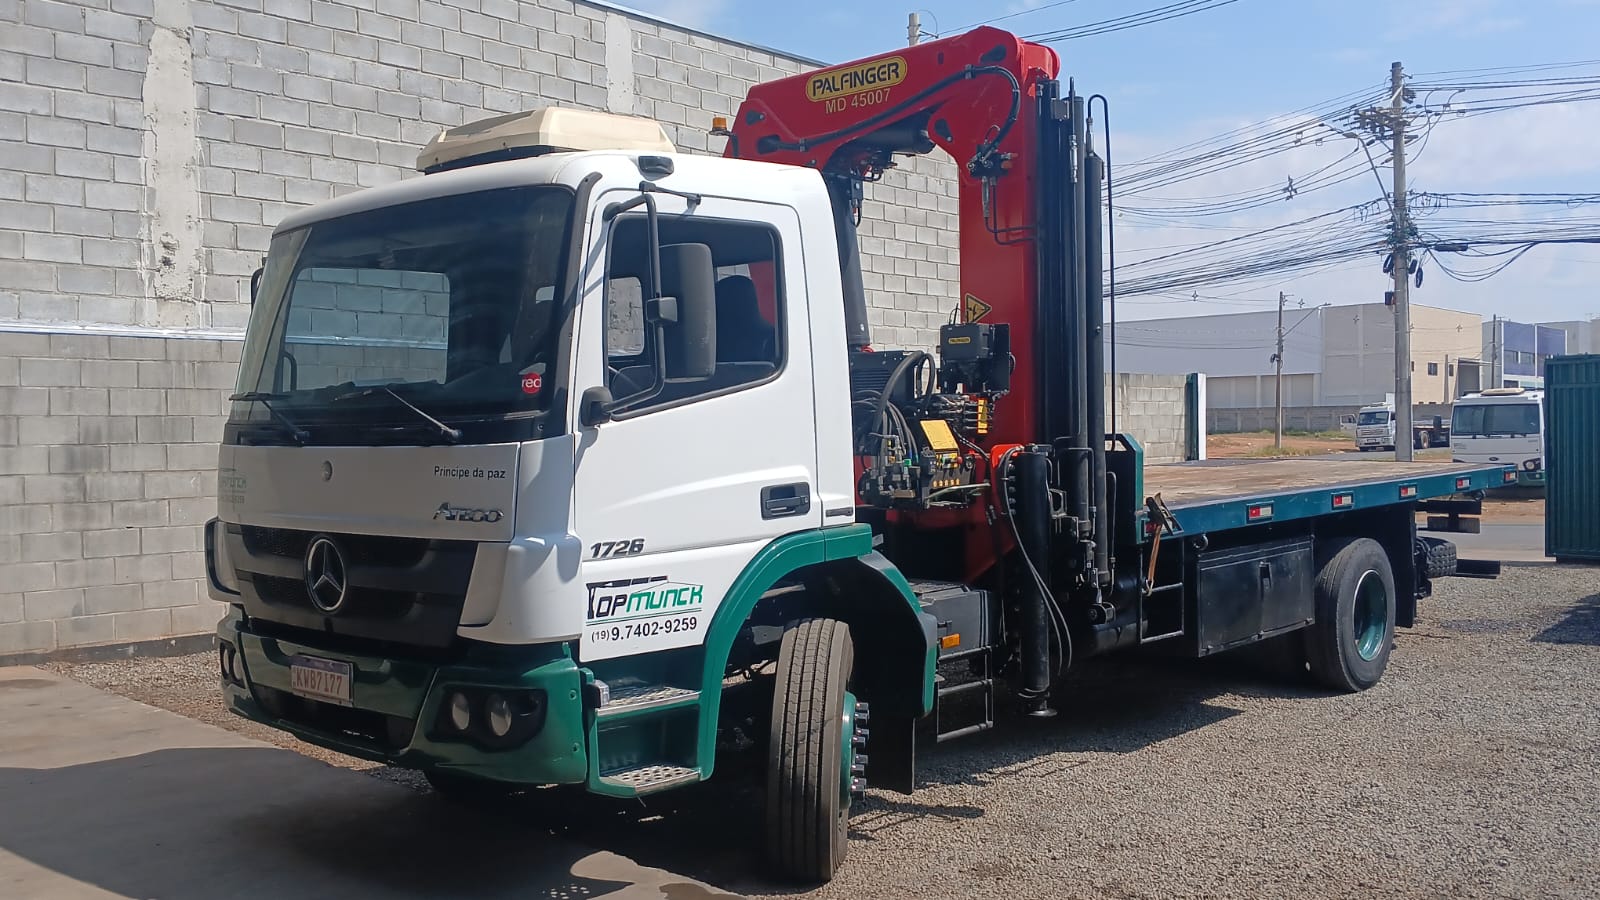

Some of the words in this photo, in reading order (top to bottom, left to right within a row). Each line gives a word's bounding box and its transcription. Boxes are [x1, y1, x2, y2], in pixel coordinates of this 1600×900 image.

[813, 61, 900, 97] PALFINGER
[825, 98, 847, 114] MD
[851, 88, 891, 108] 45007
[521, 376, 542, 388] red
[434, 465, 470, 480] Principe
[472, 467, 484, 478] da
[487, 470, 506, 480] paz
[590, 538, 645, 558] 1726
